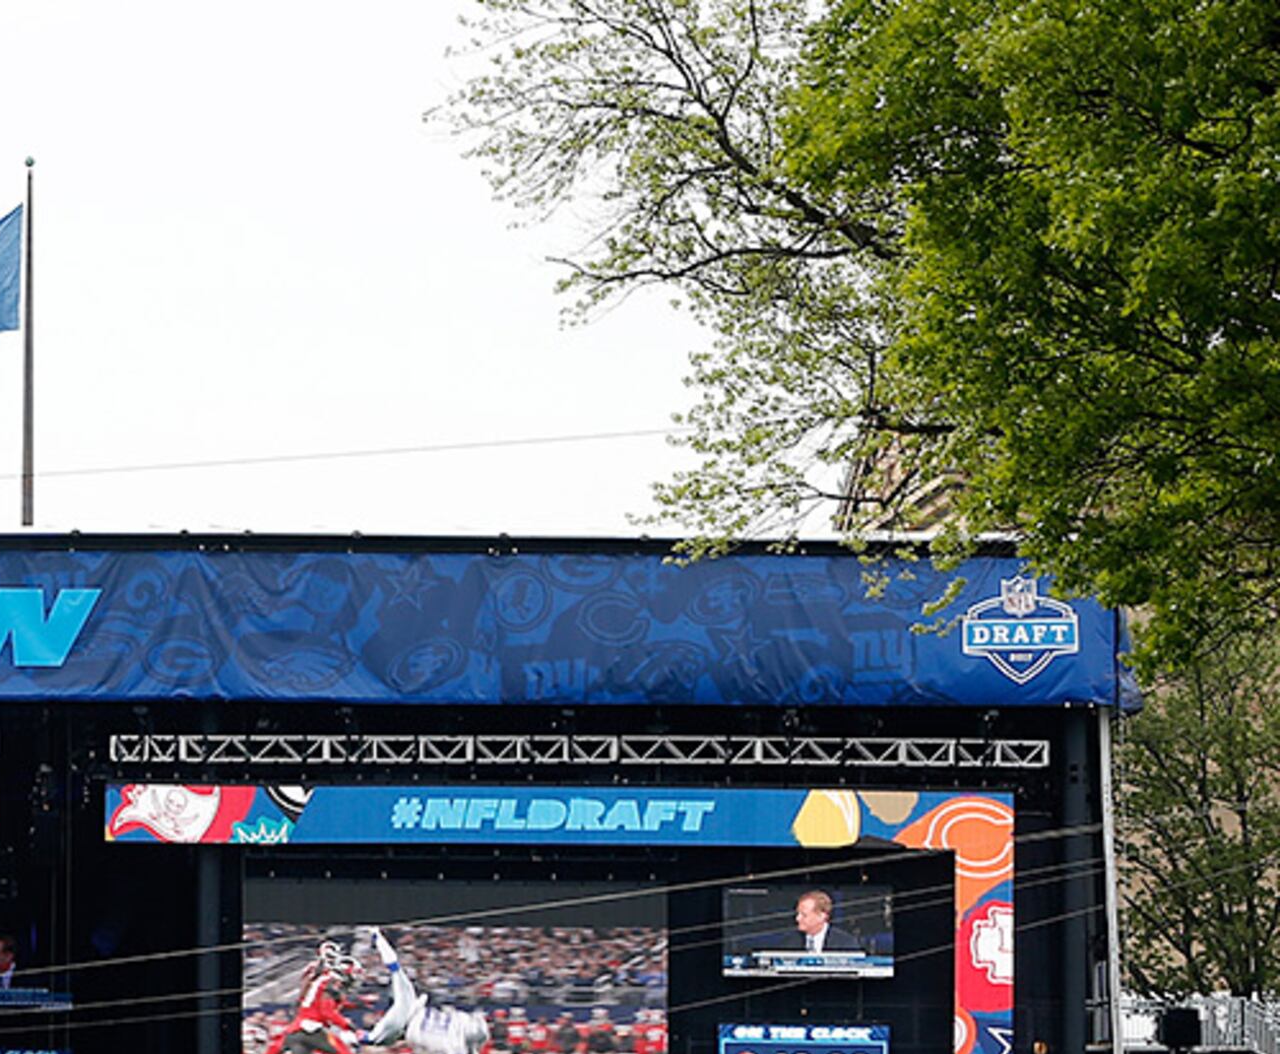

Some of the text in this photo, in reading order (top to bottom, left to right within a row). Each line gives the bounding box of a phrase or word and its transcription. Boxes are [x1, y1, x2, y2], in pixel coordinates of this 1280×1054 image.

[973, 624, 1069, 644] DRAFT
[391, 797, 714, 832] #NFLDRAFT
[734, 1027, 871, 1040] ON THE CLOCK
